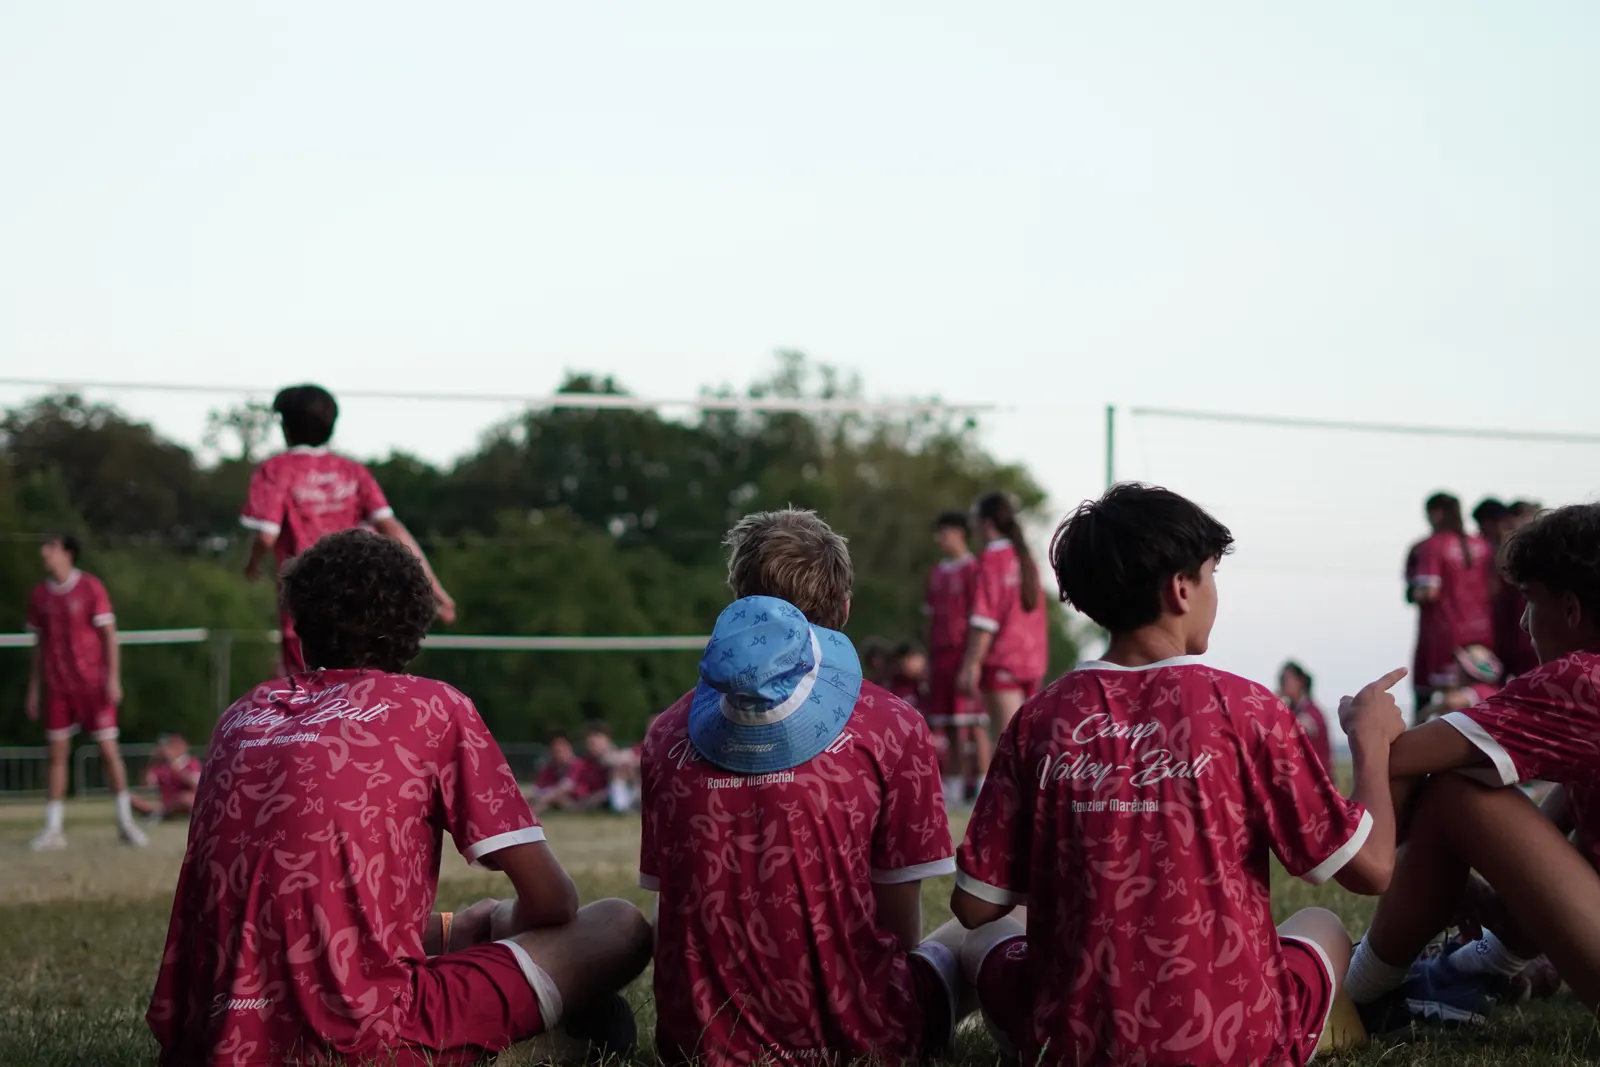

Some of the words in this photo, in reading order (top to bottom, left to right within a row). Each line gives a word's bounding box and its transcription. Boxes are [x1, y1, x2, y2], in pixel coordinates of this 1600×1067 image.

[1072, 713, 1160, 749] Camp
[238, 738, 273, 749] Rouzier
[721, 738, 778, 753] Summer
[707, 776, 745, 789] Rouzier
[1071, 800, 1107, 812] Rouzier
[1109, 798, 1159, 812] Maréchal
